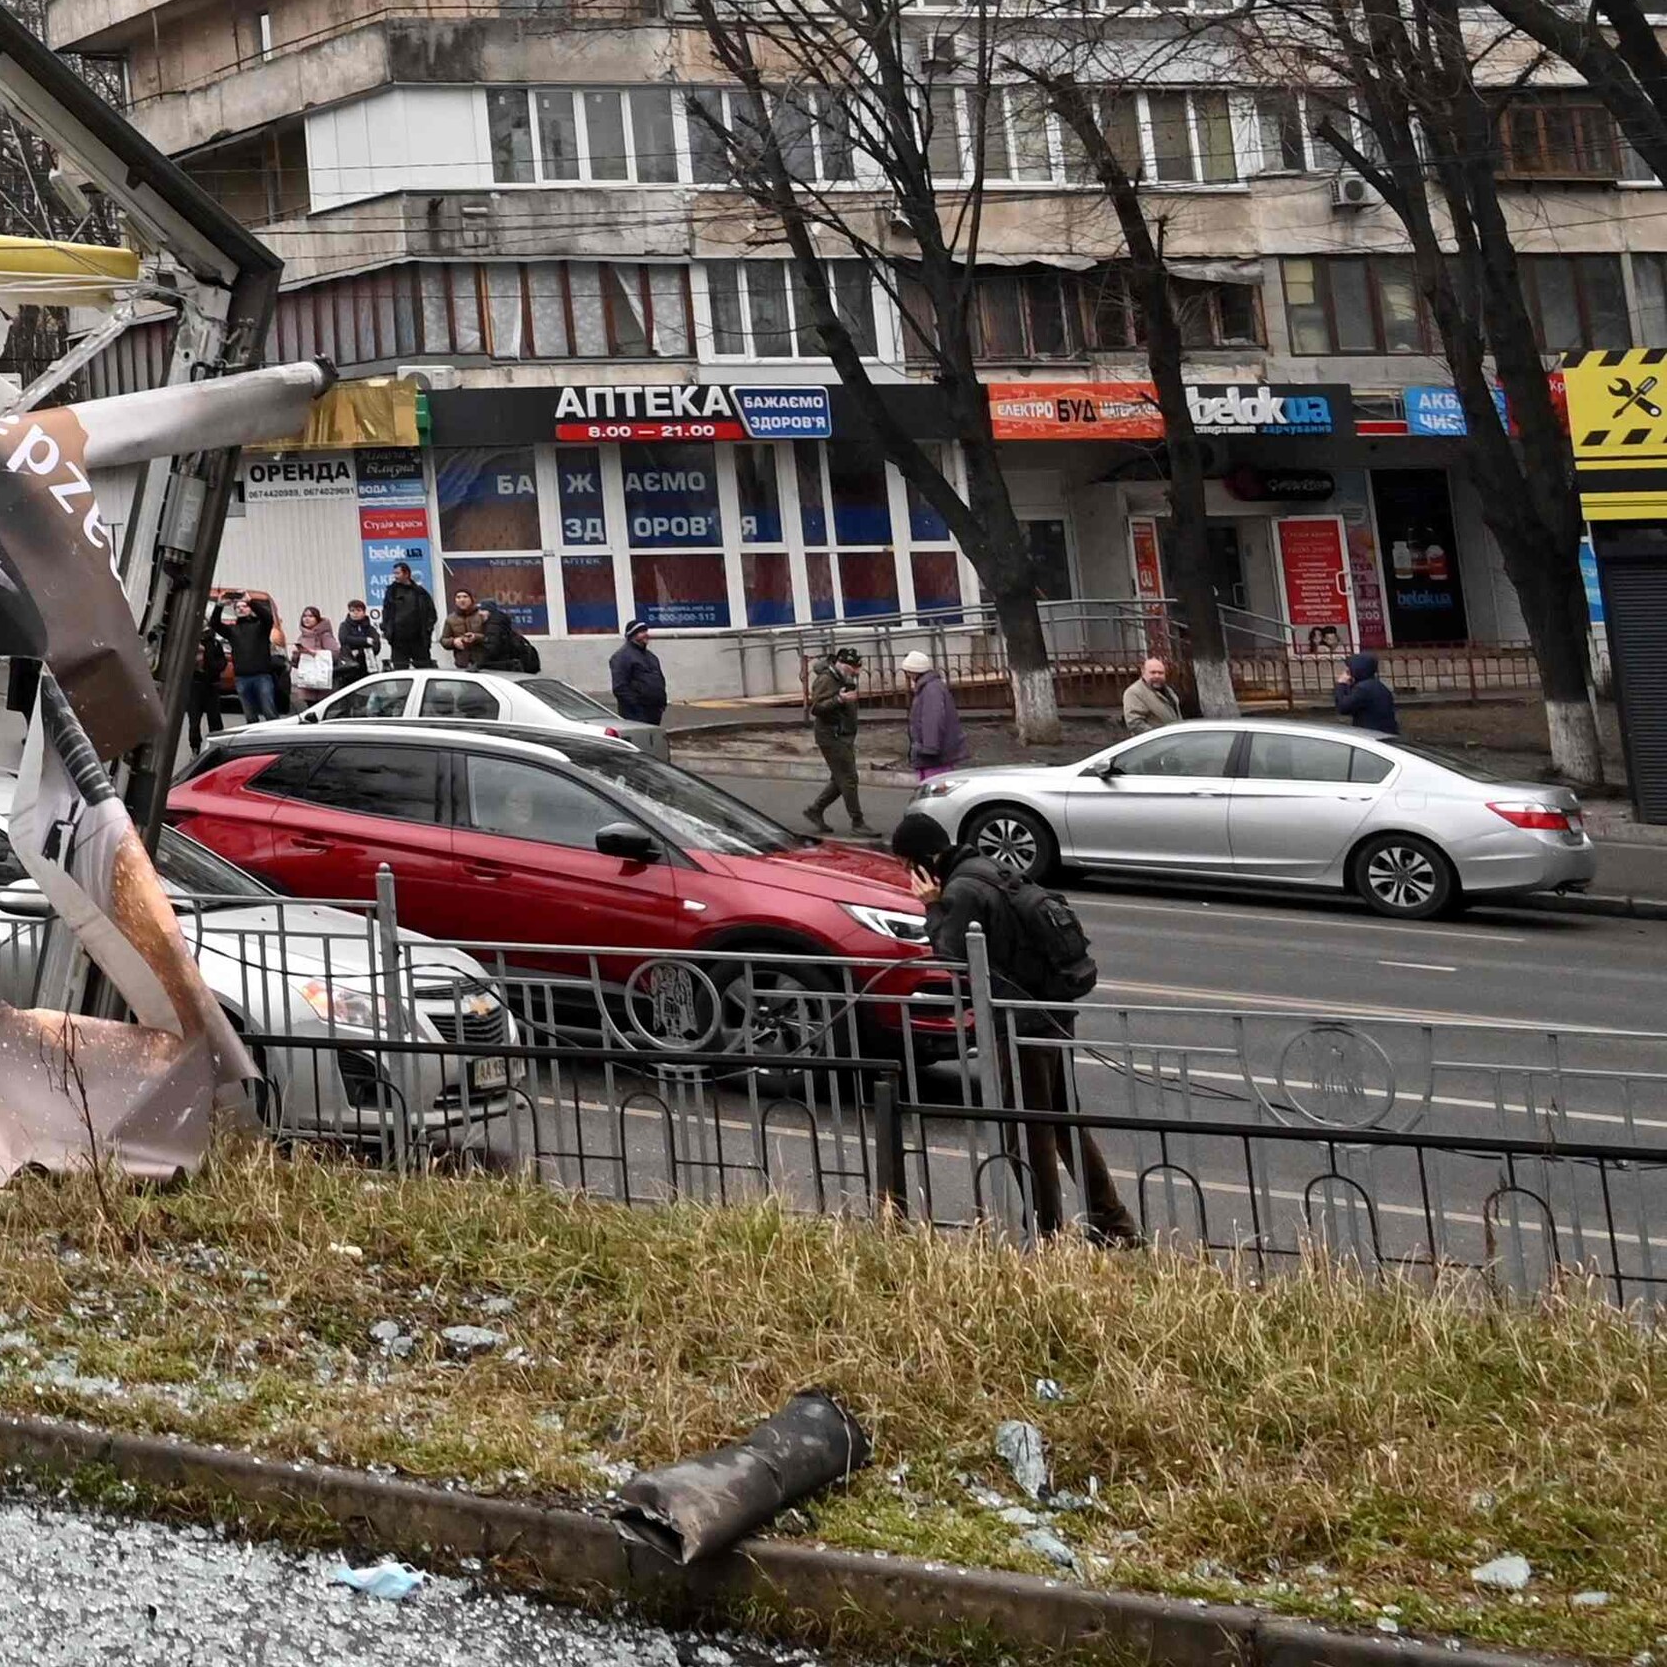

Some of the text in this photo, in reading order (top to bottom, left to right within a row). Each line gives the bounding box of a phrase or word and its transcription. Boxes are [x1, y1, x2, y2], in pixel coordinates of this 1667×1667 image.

[555, 385, 733, 419] АПТЕКА
[743, 395, 824, 409] БАЖАЄМО
[1057, 399, 1097, 423] БУД
[587, 425, 632, 438] 8.00
[660, 425, 716, 438] 21.00
[750, 415, 827, 430] ЗДОРОВ'Я
[249, 461, 352, 484] ОРЕНДА
